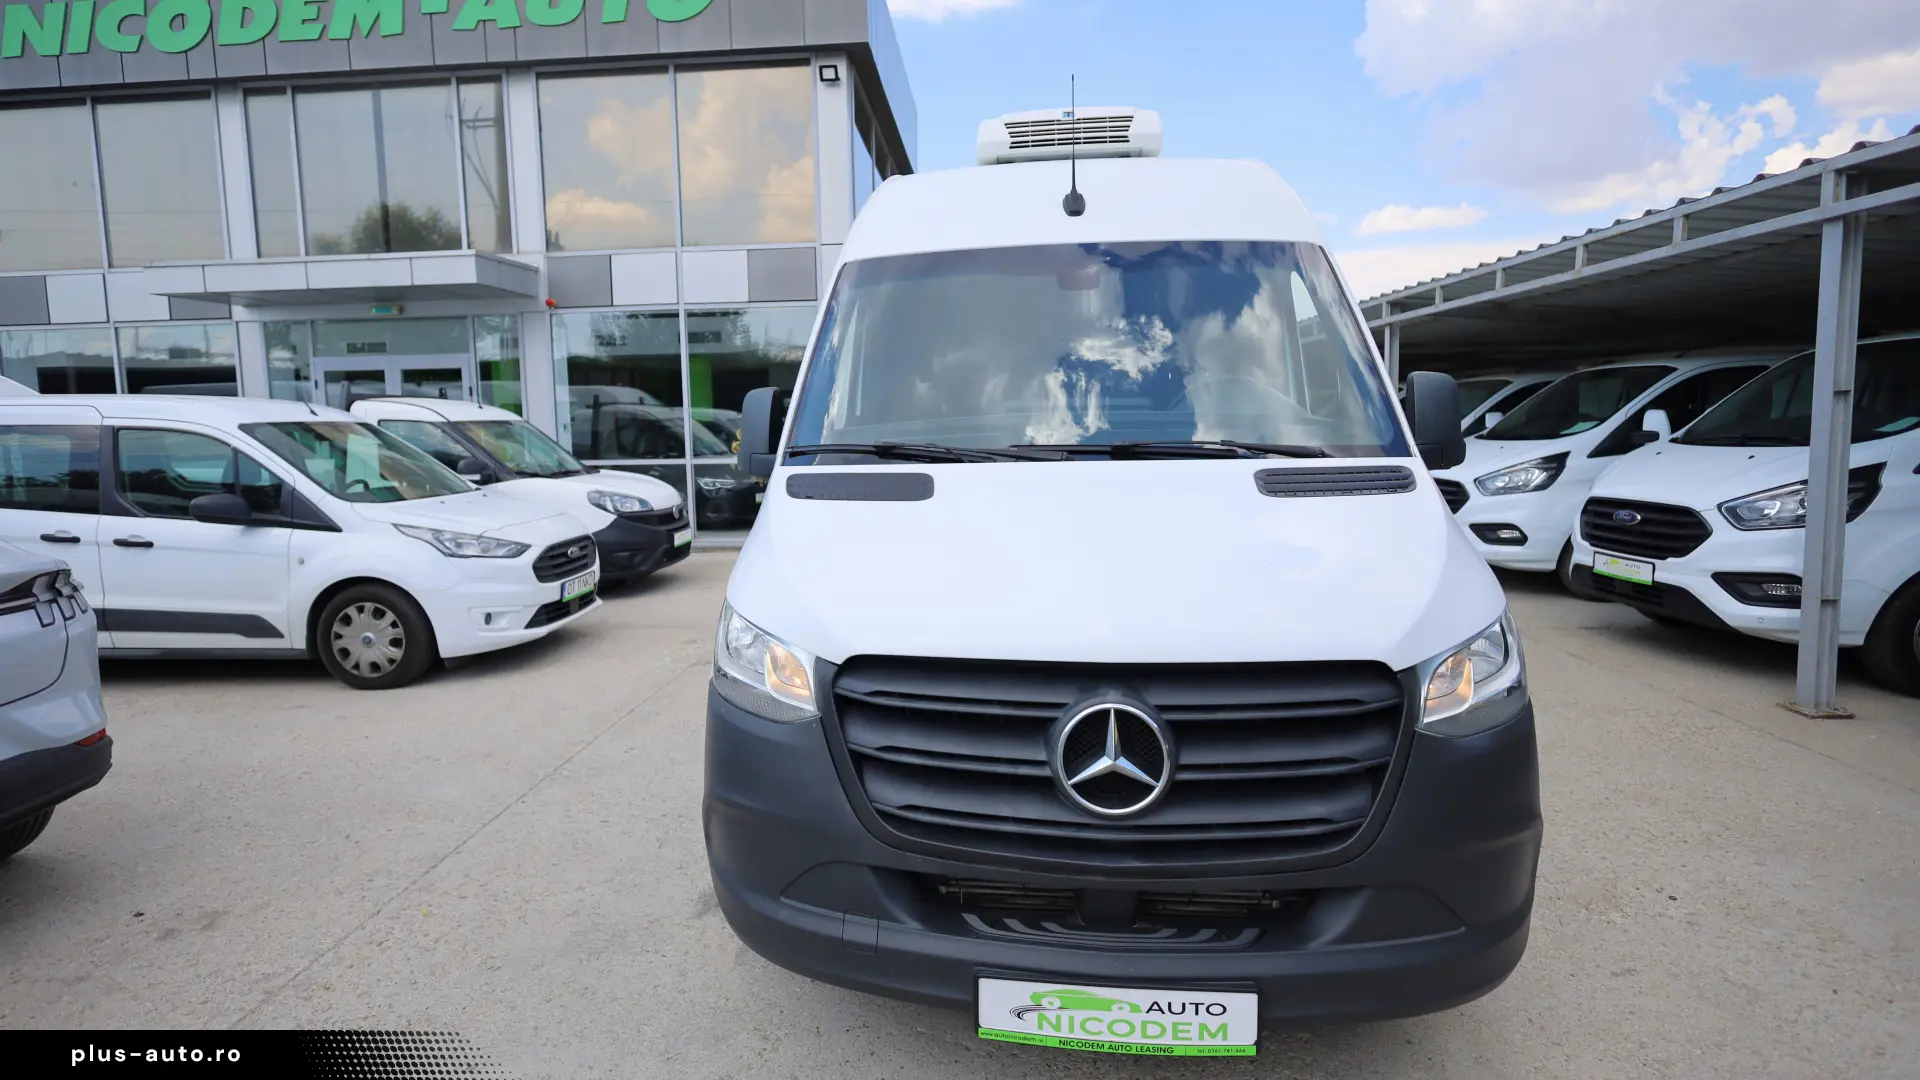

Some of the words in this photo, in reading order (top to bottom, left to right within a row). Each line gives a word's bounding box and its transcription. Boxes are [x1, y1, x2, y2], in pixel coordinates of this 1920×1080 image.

[1145, 1000, 1228, 1017] AUTO
[1037, 1012, 1229, 1042] NICODEM
[1058, 1039, 1105, 1051] NICODEM
[1107, 1043, 1133, 1053] AUTO
[1135, 1045, 1175, 1055] LEASING
